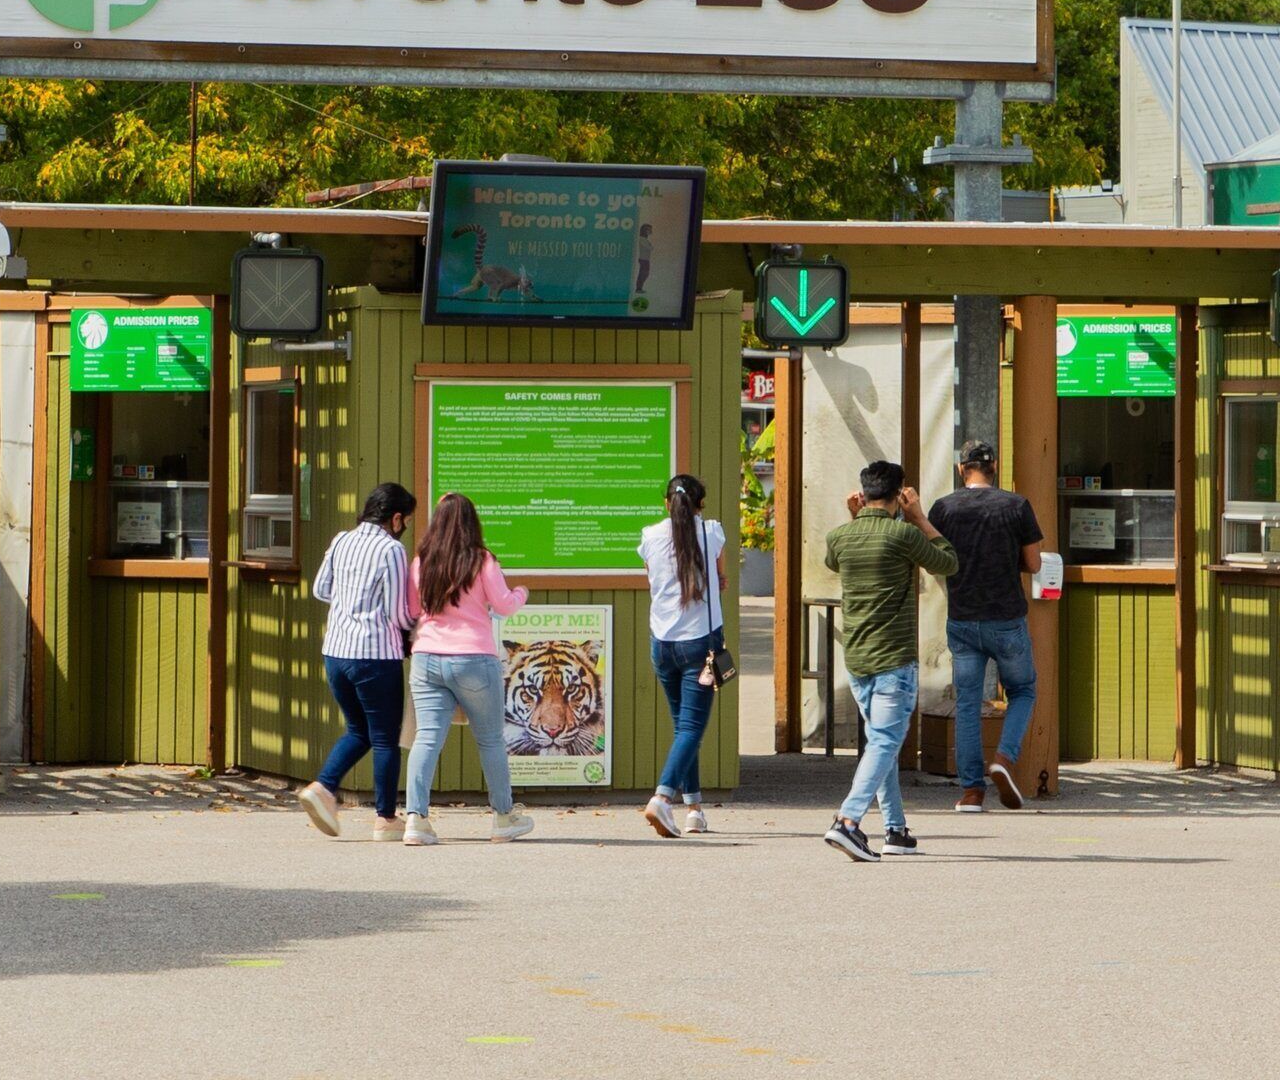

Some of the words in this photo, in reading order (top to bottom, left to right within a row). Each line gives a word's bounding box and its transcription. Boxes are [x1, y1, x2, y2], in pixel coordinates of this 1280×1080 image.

[474, 187, 570, 206] Welcome
[577, 191, 601, 207] to
[499, 211, 586, 229] Toronto
[594, 213, 634, 230] Zoo
[113, 315, 166, 326] ADMISSION
[167, 315, 199, 326] PRICES
[1083, 323, 1137, 334] ADMISSION
[1139, 323, 1172, 333] PRICES
[504, 392, 538, 401] SAFETY
[540, 392, 572, 401] COMES
[574, 393, 601, 401] FIRST!
[504, 614, 564, 626] ADOPT
[568, 614, 600, 626] ME!
